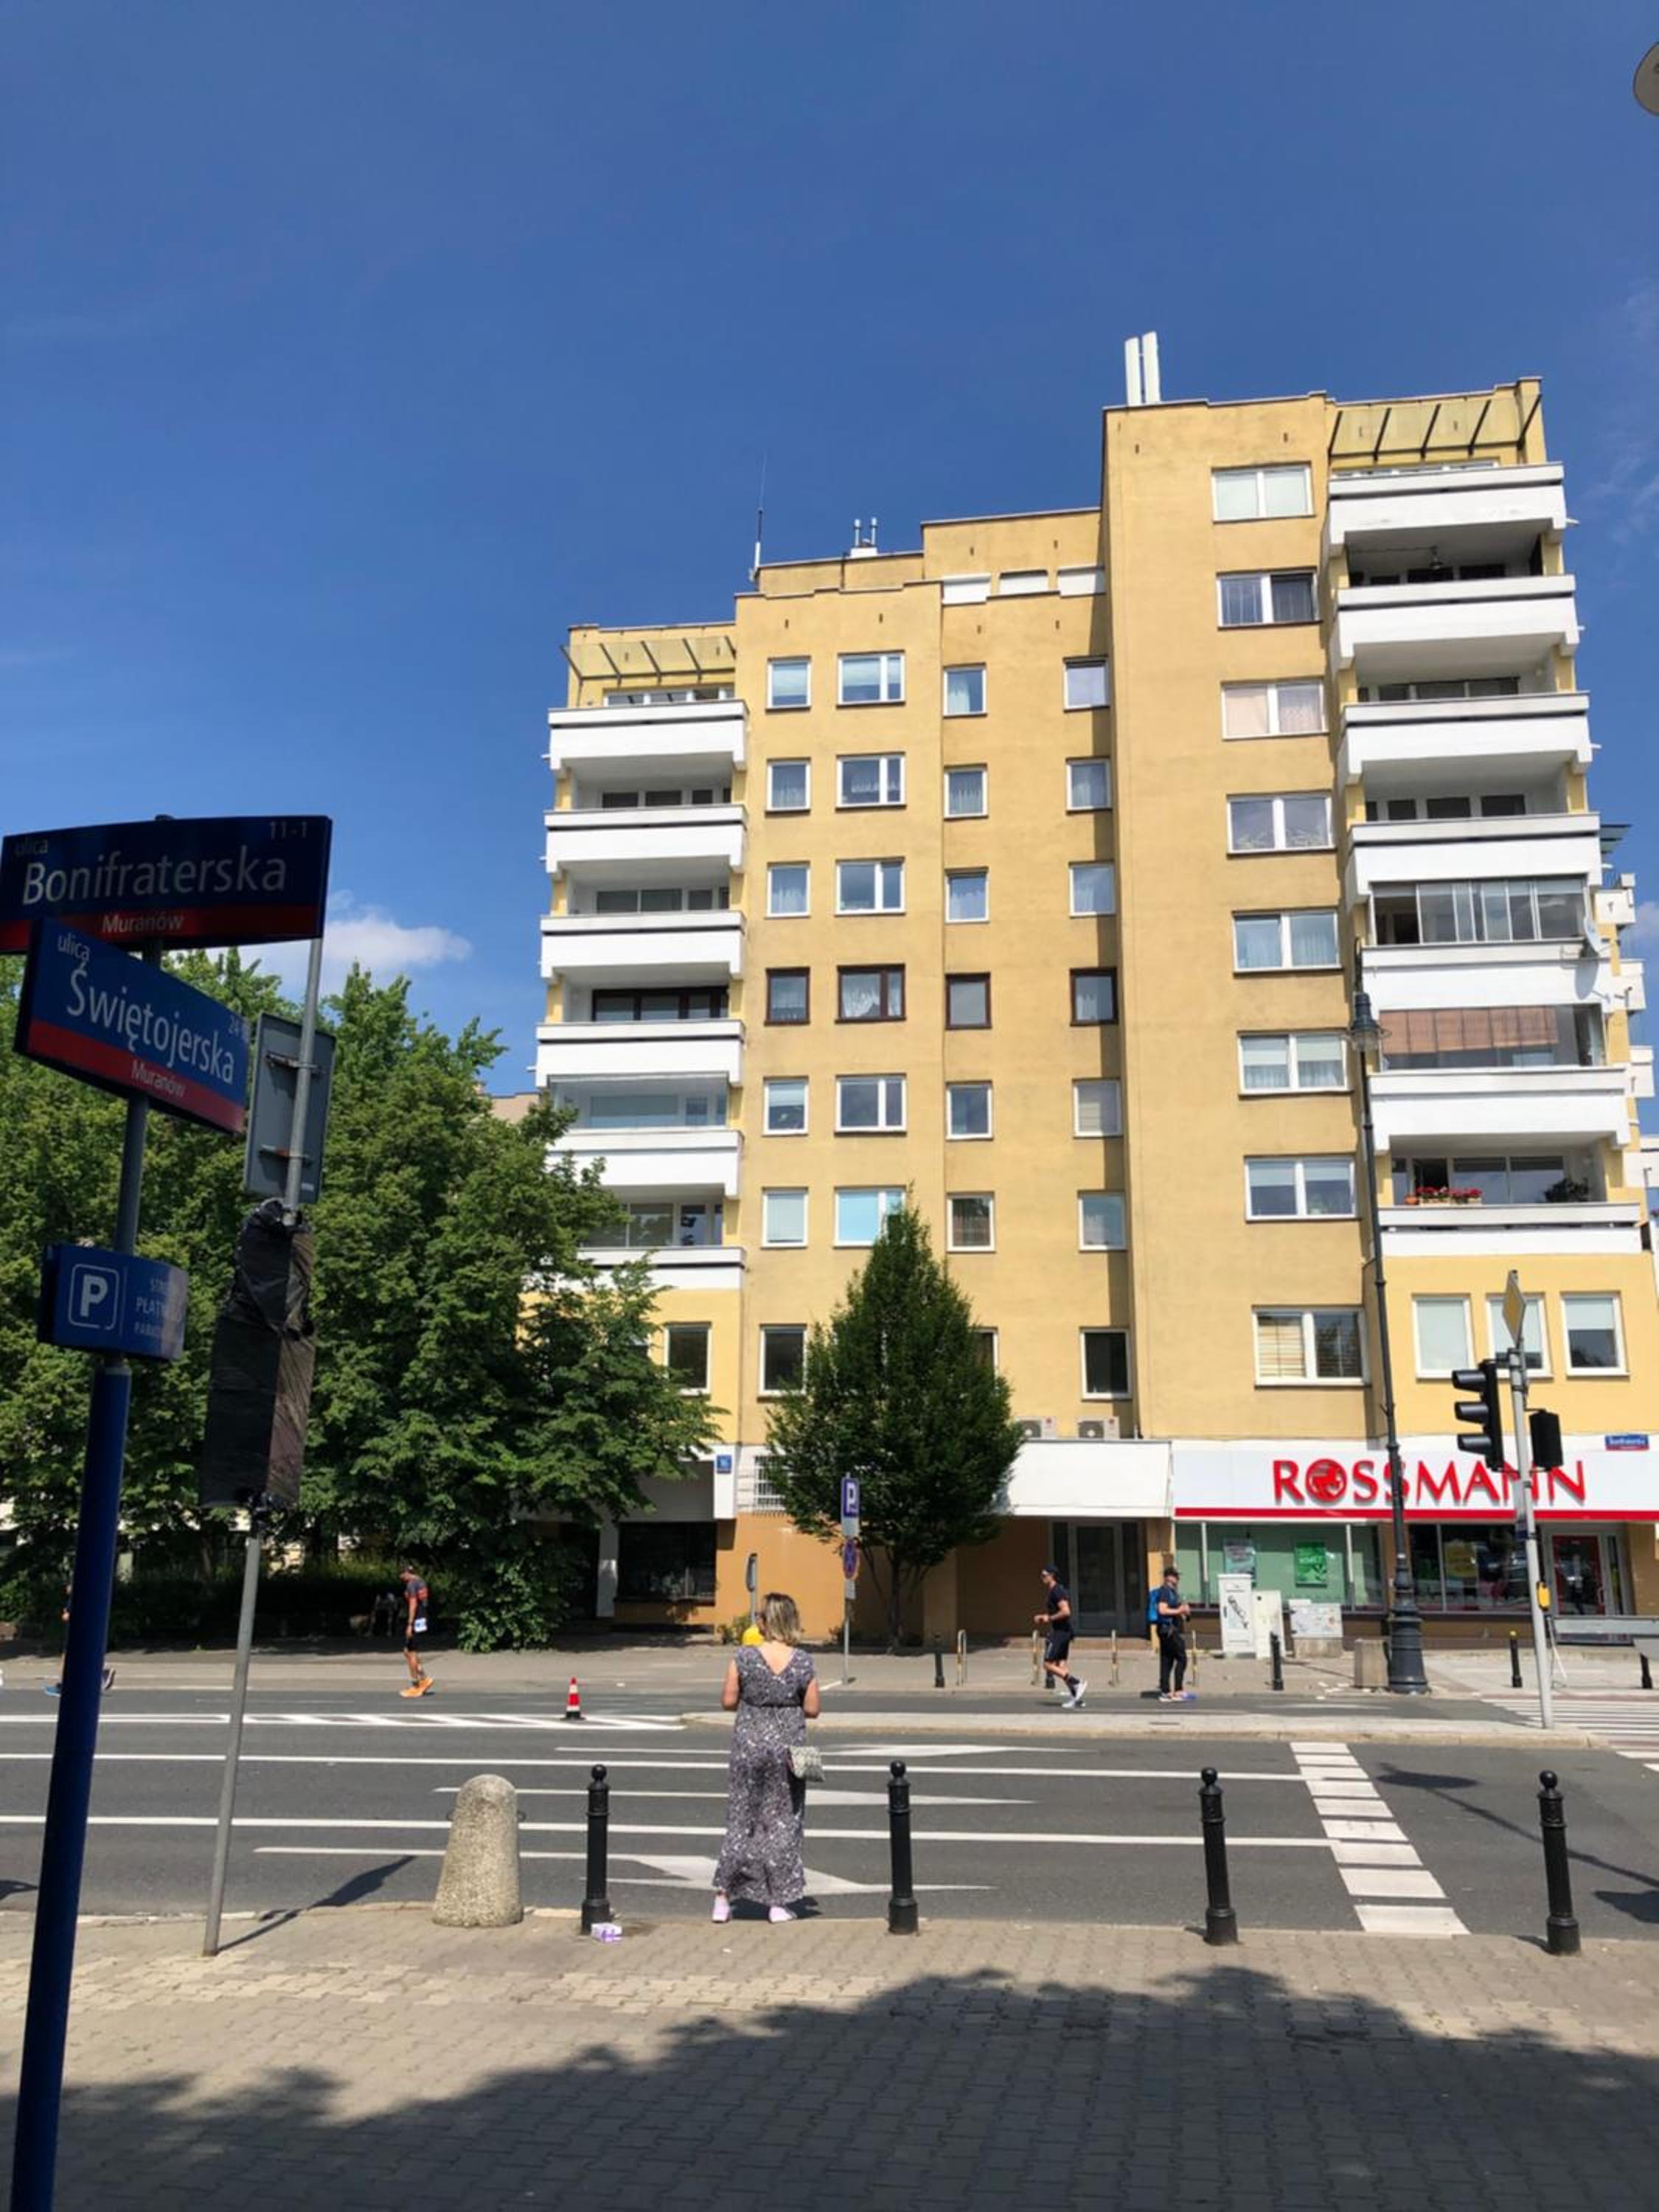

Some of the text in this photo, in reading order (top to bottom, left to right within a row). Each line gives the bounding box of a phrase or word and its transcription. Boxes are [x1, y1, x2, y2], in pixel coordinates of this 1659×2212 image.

[15, 838, 49, 856] ulica
[22, 845, 287, 905] Bonifraterska
[102, 913, 184, 933] Muranów
[58, 932, 91, 960] ulica
[67, 960, 235, 1085] Świętojerska
[131, 1060, 186, 1098] Muranów
[79, 1274, 108, 1318] P
